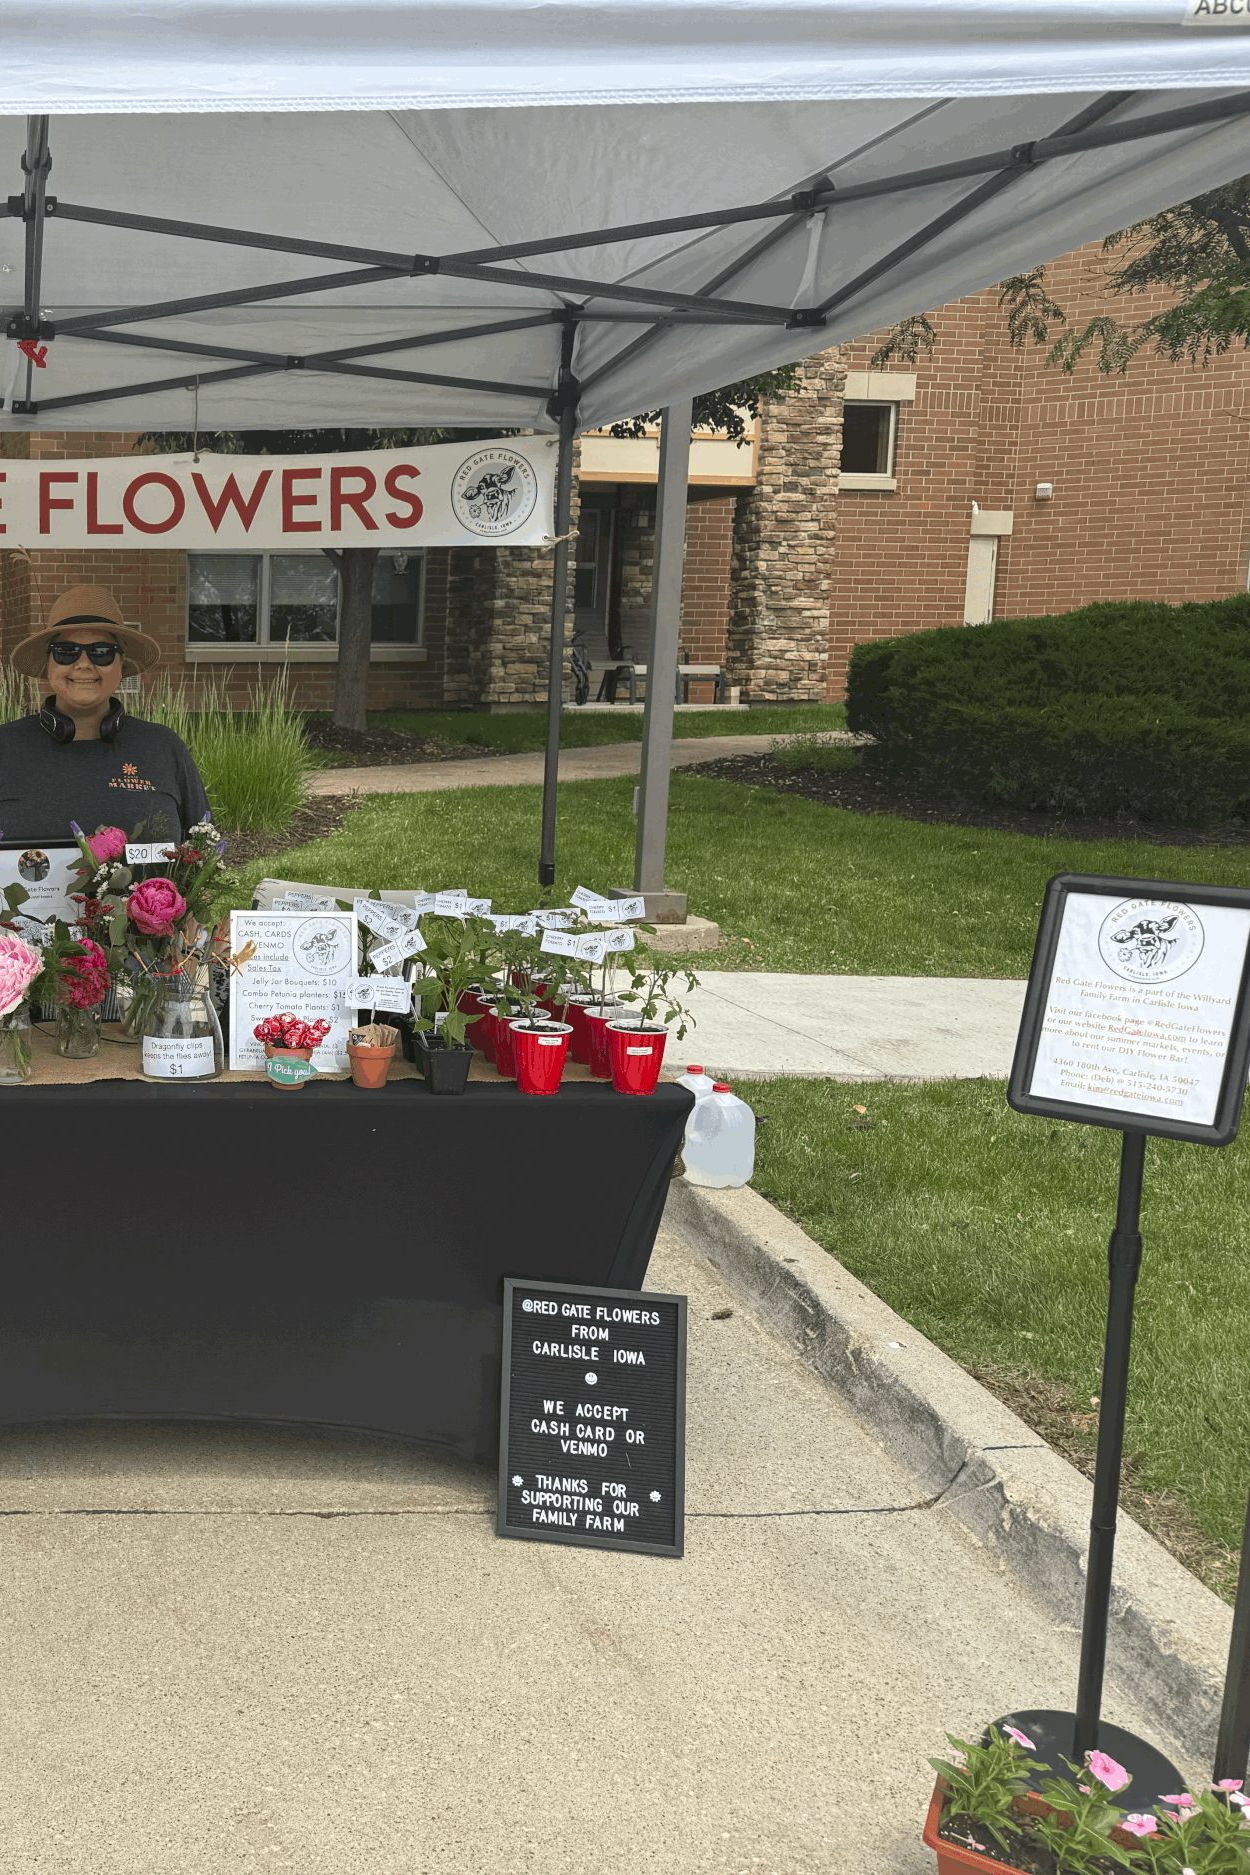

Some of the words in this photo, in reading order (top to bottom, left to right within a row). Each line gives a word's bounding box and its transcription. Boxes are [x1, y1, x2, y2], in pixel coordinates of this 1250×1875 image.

[460, 465, 472, 480] RED
[473, 454, 494, 466] GATE
[498, 454, 530, 479] FLOWERS
[39, 464, 424, 534] FLOWERS
[128, 848, 148, 860] $20
[362, 904, 382, 920] PEPPERS
[363, 914, 372, 926] $2
[1112, 908, 1128, 923] RED
[1131, 900, 1156, 910] GATE
[1160, 901, 1196, 931] FLOWERS
[238, 930, 262, 938] CASH,
[264, 930, 292, 938] CARDS
[258, 920, 286, 928] accept:
[264, 952, 288, 961] include
[382, 956, 393, 966] $2
[248, 964, 266, 972] Sales
[268, 964, 282, 972] Tax
[252, 978, 268, 986] Jelly
[284, 979, 320, 987] Bouquets:
[1056, 976, 1070, 984] Red
[1073, 978, 1092, 988] Gate
[1094, 982, 1127, 992] Flowers
[1165, 990, 1176, 998] of
[1177, 992, 1191, 1000] the
[1193, 994, 1232, 1005] Willyard
[270, 990, 297, 998] Petunia
[300, 990, 330, 1000] planters:
[1080, 990, 1107, 1001] Family
[1109, 994, 1130, 1002] Farm
[1132, 996, 1140, 1004] in
[1142, 998, 1175, 1008] Carlisle
[1178, 1002, 1199, 1012] Iowa
[248, 1002, 274, 1010] Cherry
[276, 1002, 302, 1010] Tomato
[1049, 1006, 1067, 1014] Visit
[1085, 1010, 1122, 1022] facebook
[1124, 1018, 1145, 1026] page
[1064, 1028, 1088, 1038] about
[1107, 1036, 1141, 1046] summer
[1142, 1041, 1180, 1052] markets,
[1182, 1046, 1212, 1057] events,
[1075, 1020, 1106, 1030] website
[1189, 1036, 1198, 1044] to
[1200, 1037, 1224, 1047] learn
[144, 1052, 162, 1060] keeps
[194, 1050, 212, 1059] away!
[152, 1042, 184, 1051] Dragonfly
[186, 1042, 203, 1050] clips
[1082, 1042, 1100, 1050] rent
[1118, 1046, 1136, 1055] DIY
[1137, 1050, 1167, 1060] Flower
[1170, 1054, 1188, 1064] Bar!
[170, 1063, 182, 1075] $1
[266, 1062, 272, 1072] I
[274, 1063, 294, 1076] Pick
[294, 1066, 311, 1080] you!
[1052, 1058, 1074, 1067] 4360
[1076, 1061, 1100, 1070] 180th
[1102, 1066, 1120, 1074] Ave,
[1122, 1068, 1156, 1081] Carlisle,
[1159, 1074, 1170, 1082] IA
[1172, 1076, 1200, 1086] 50047
[1060, 1068, 1088, 1080] Phone:
[1090, 1074, 1114, 1084] (Deb)
[1126, 1080, 1188, 1096] 515-240-5730
[1060, 1079, 1086, 1090] Email:
[522, 1299, 558, 1315] @RED
[562, 1303, 592, 1318] GATE
[596, 1307, 660, 1325] FLOWERS
[572, 1324, 609, 1341] FROM
[532, 1340, 600, 1360] CARLISLE
[614, 1350, 646, 1366] IOWA
[543, 1400, 564, 1414] WE
[576, 1404, 629, 1422] ACCEPT
[531, 1418, 570, 1436] CASH
[576, 1424, 615, 1441] CARD
[626, 1429, 645, 1444] OR
[560, 1438, 608, 1458] VENMO
[535, 1474, 588, 1494] THANKS
[602, 1482, 627, 1498] FOR
[521, 1490, 602, 1512] SUPPORTING
[613, 1500, 640, 1516] OUR
[532, 1508, 578, 1527] FAMILY
[586, 1515, 624, 1532] FARM
